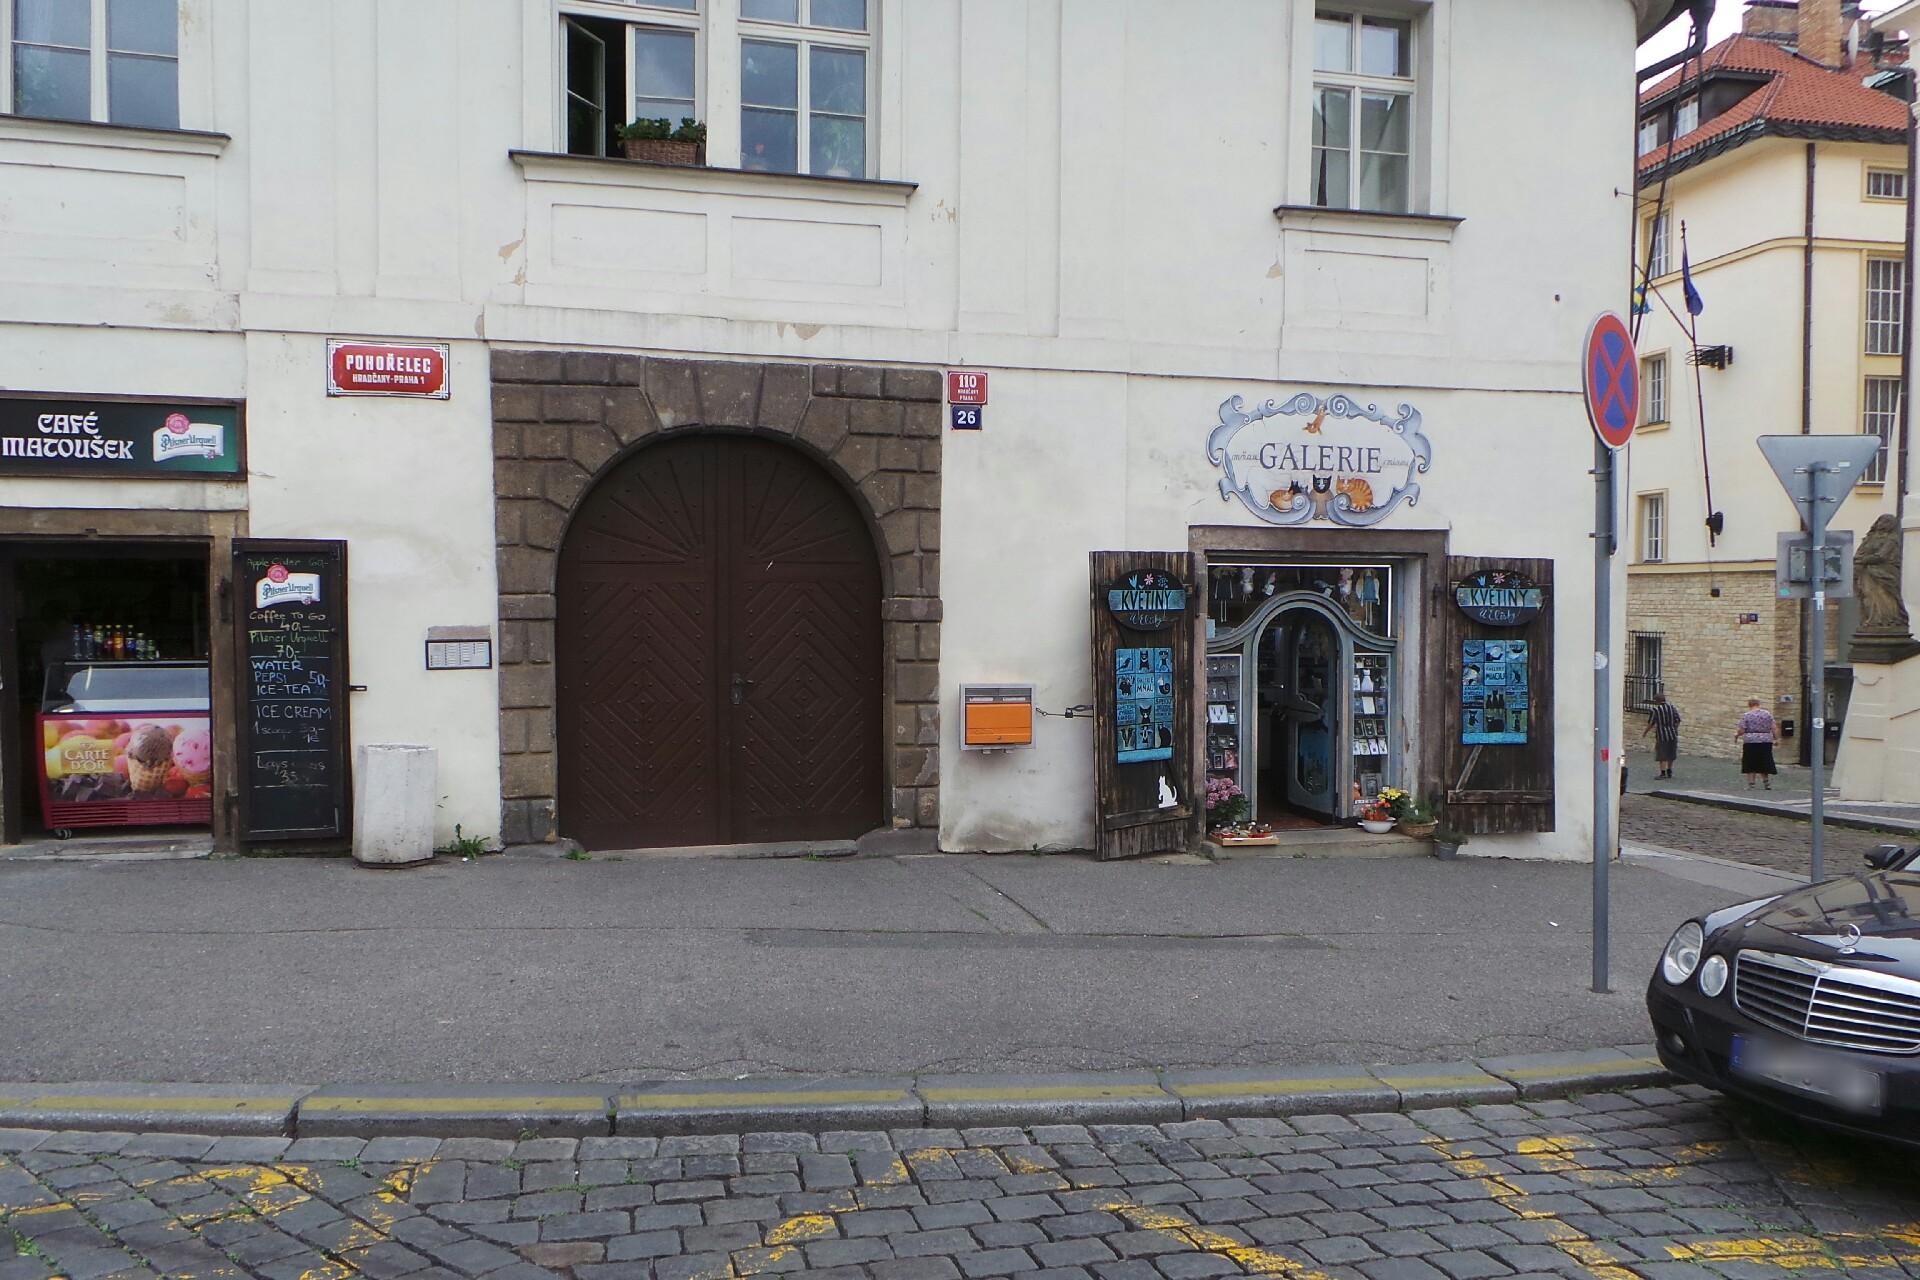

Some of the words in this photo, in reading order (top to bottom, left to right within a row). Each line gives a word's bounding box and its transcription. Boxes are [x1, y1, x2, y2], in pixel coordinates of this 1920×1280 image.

[345, 353, 431, 373] POHOŘELEC
[958, 374, 977, 388] 110
[37, 411, 99, 434] CAFÉ
[957, 410, 976, 425] 26
[1, 435, 134, 460] MATOUŠEK
[160, 434, 190, 452] Pilsner
[189, 434, 217, 446] Urquell
[1259, 443, 1382, 474] GALERIE
[262, 583, 289, 600] Pilsner
[287, 583, 314, 593] Urquell
[1469, 585, 1529, 607] KVĚTINY
[249, 610, 286, 623] Coffee
[251, 660, 304, 671] WATER
[254, 671, 288, 684] PEPSI
[256, 684, 312, 696] ICE-TEA
[256, 705, 281, 719] ICE
[284, 705, 332, 720] CREAM
[64, 749, 110, 761] CARTE
